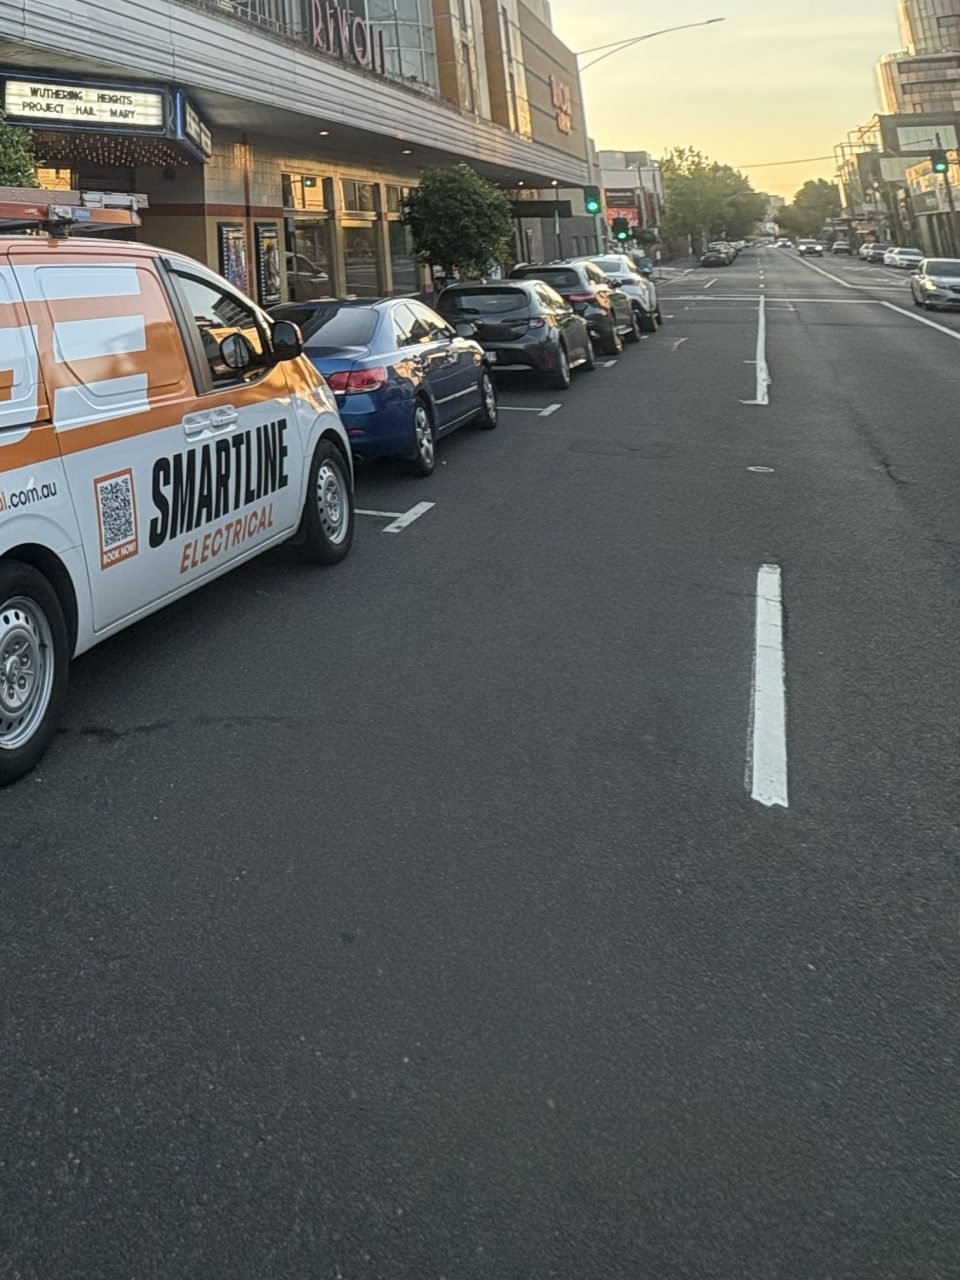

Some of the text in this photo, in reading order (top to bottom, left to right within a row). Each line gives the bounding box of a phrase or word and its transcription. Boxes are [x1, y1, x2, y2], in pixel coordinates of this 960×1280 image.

[29, 86, 133, 105] WUTHERING HEIGHTS
[22, 101, 136, 119] PROJECT HAIL MARY
[148, 417, 289, 549] SMARTLINE
[179, 502, 274, 575] ELECTRICAL
[103, 548, 120, 565] BOOK
